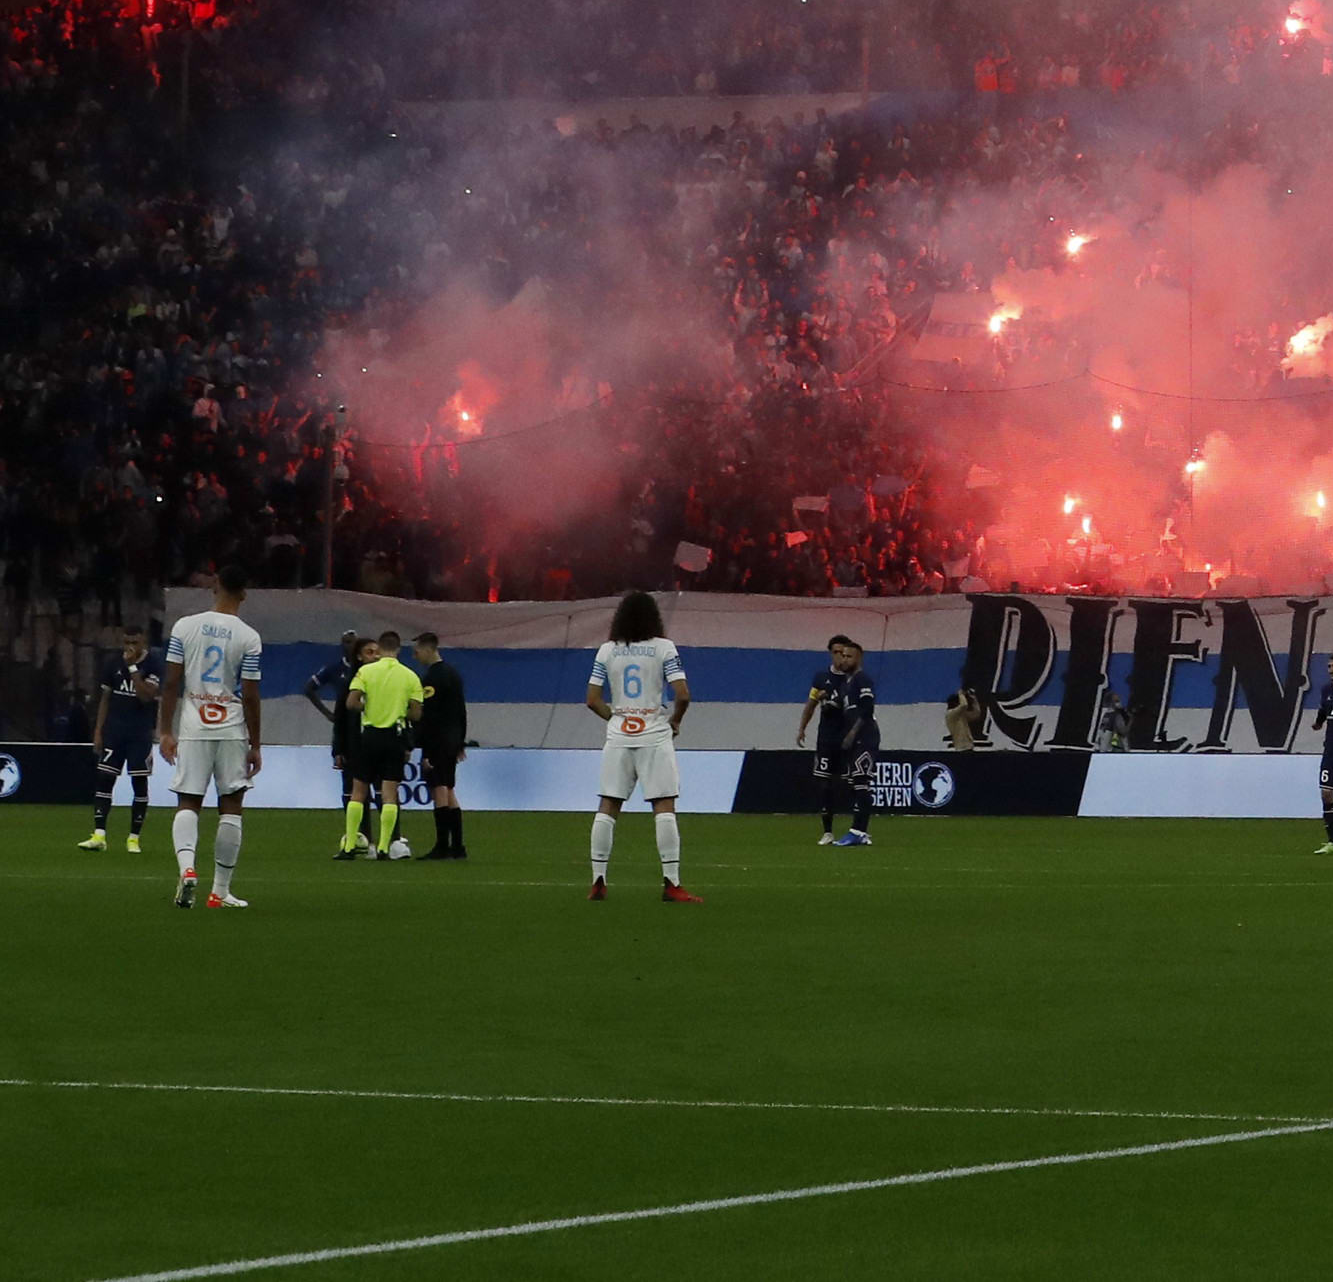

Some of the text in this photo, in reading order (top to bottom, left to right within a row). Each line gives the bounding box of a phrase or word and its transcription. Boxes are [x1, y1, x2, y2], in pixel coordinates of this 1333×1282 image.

[200, 645, 224, 683] 2
[952, 592, 1327, 752] RIEN
[623, 664, 642, 699] 6
[103, 748, 114, 762] 7
[820, 757, 829, 770] 5
[1321, 770, 1329, 783] 6
